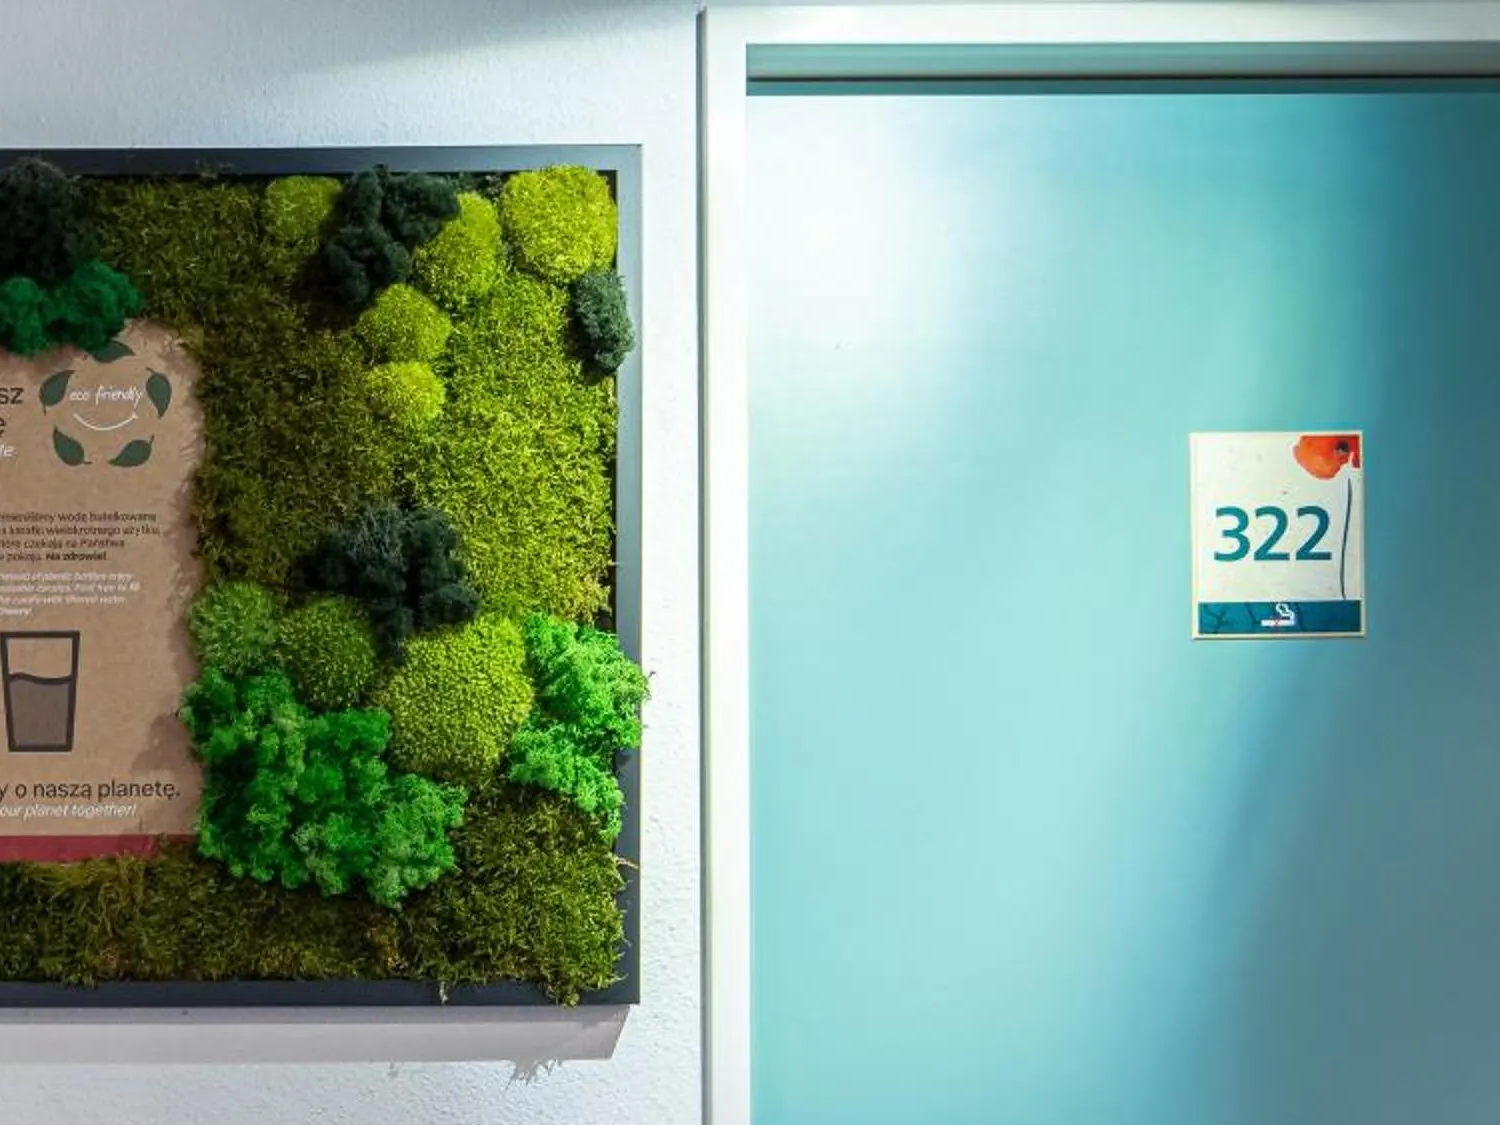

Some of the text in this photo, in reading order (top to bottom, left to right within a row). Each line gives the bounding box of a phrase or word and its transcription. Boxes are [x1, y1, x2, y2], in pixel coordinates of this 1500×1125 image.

[68, 384, 143, 409] eco friendly
[1213, 505, 1333, 562] 322
[14, 783, 27, 798] o
[33, 783, 92, 801] naszą
[97, 779, 181, 802] planetę.
[0, 807, 21, 817] our
[22, 803, 70, 820] planet
[71, 803, 138, 819] together!
